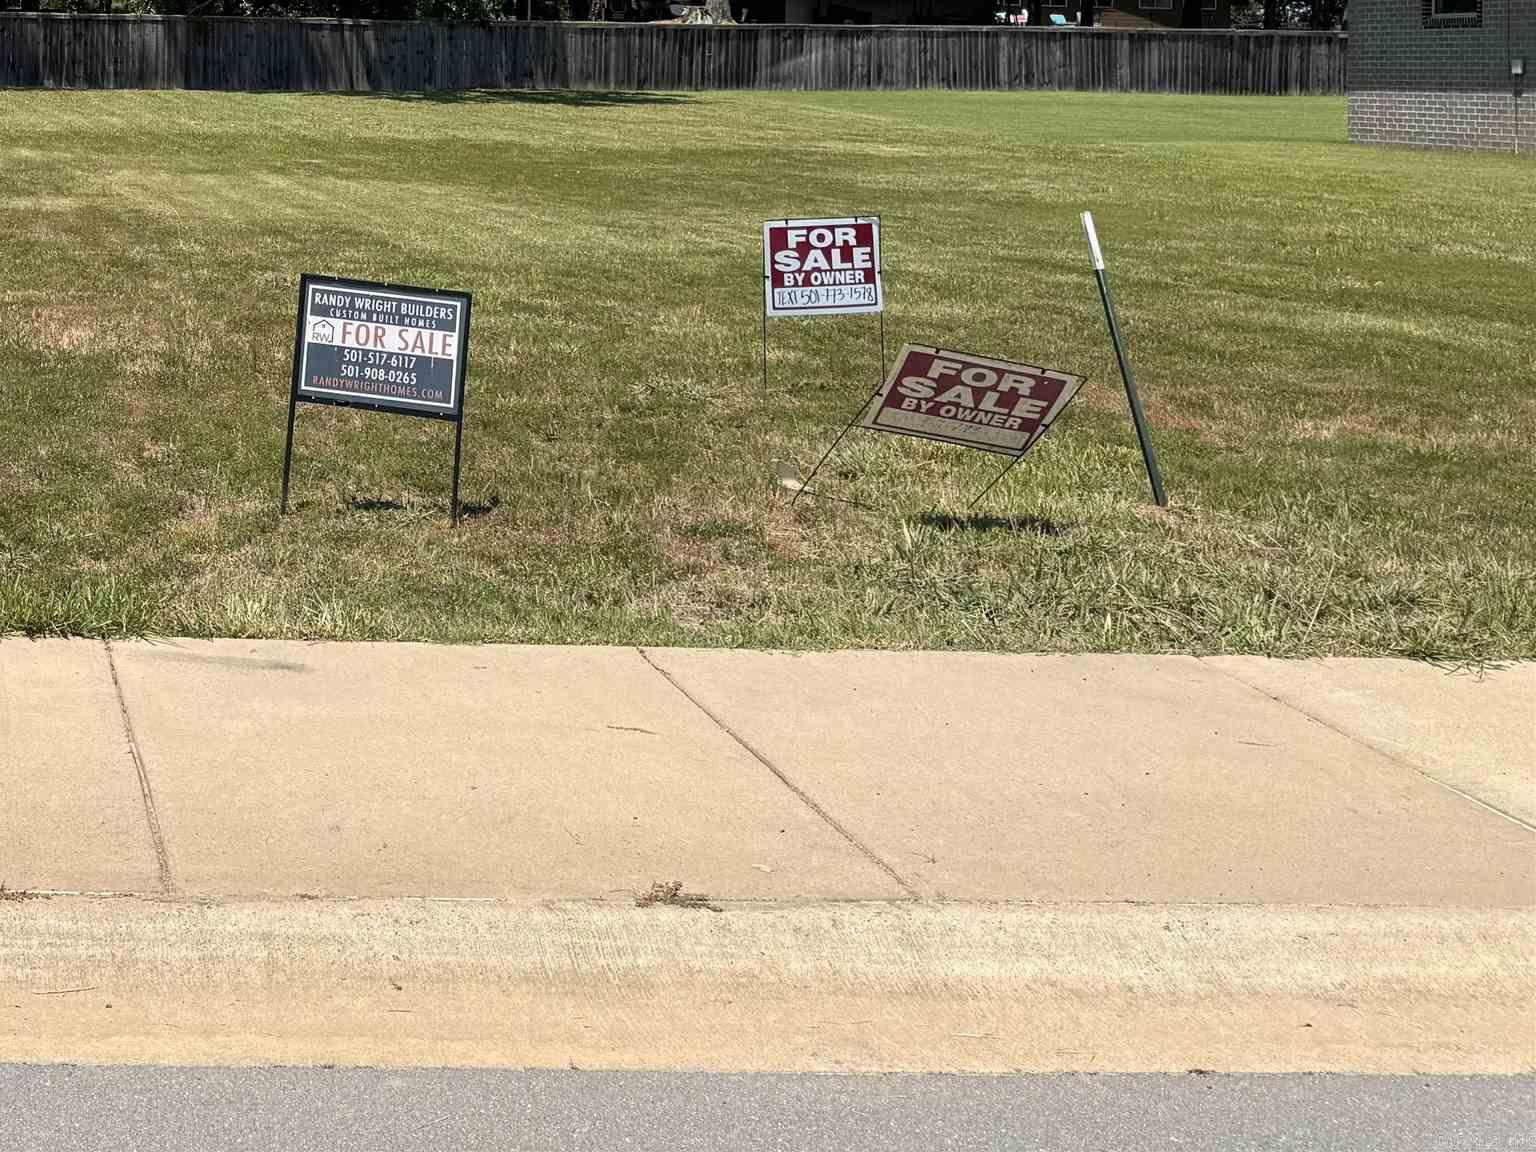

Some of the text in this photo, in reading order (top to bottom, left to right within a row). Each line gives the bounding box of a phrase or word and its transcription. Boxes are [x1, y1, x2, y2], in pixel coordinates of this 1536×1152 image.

[787, 227, 857, 248] FOR
[774, 247, 872, 272] SALE
[784, 270, 865, 286] BY OWNER
[314, 292, 454, 320] RANDY WRIGHT BUILDERS
[329, 308, 437, 329] CUSTOM BUILT HOMES
[341, 321, 454, 357] FOR SALE
[343, 349, 416, 369] 501-517-6117
[340, 364, 417, 384] 501-908-0265
[927, 358, 1036, 396] FOR
[312, 375, 443, 400] RANDYWRIGHTHOMES.COM
[897, 376, 1048, 419] SALE
[900, 398, 935, 413] BY
[939, 405, 1022, 429] OWNER
